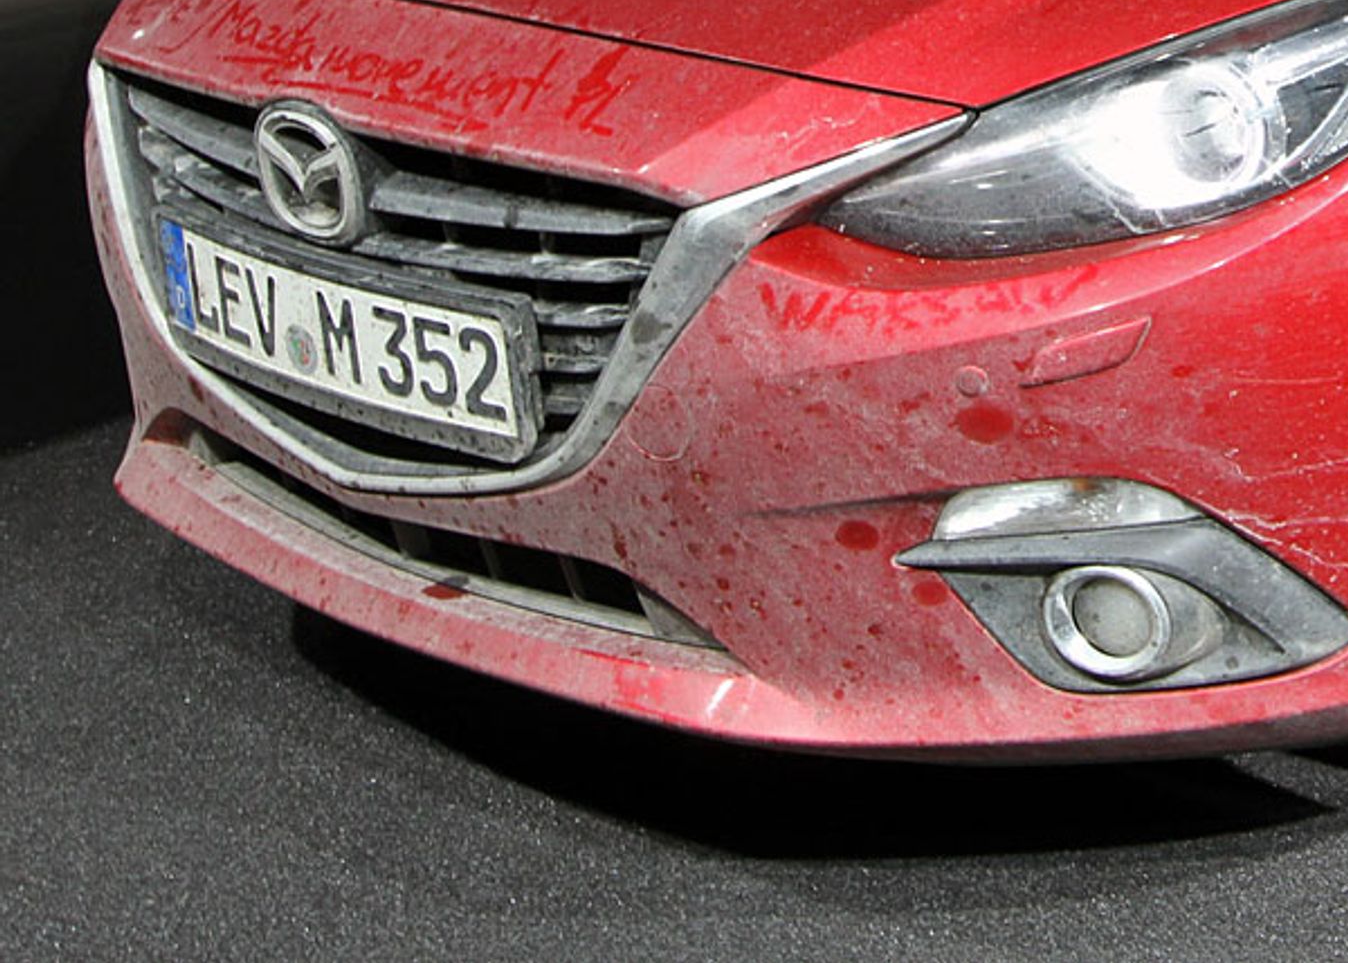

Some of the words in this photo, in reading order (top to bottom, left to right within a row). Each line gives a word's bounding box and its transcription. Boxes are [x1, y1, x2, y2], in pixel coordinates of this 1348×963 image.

[186, 241, 276, 358] LEV
[315, 290, 363, 386] M
[371, 305, 508, 424] 352
